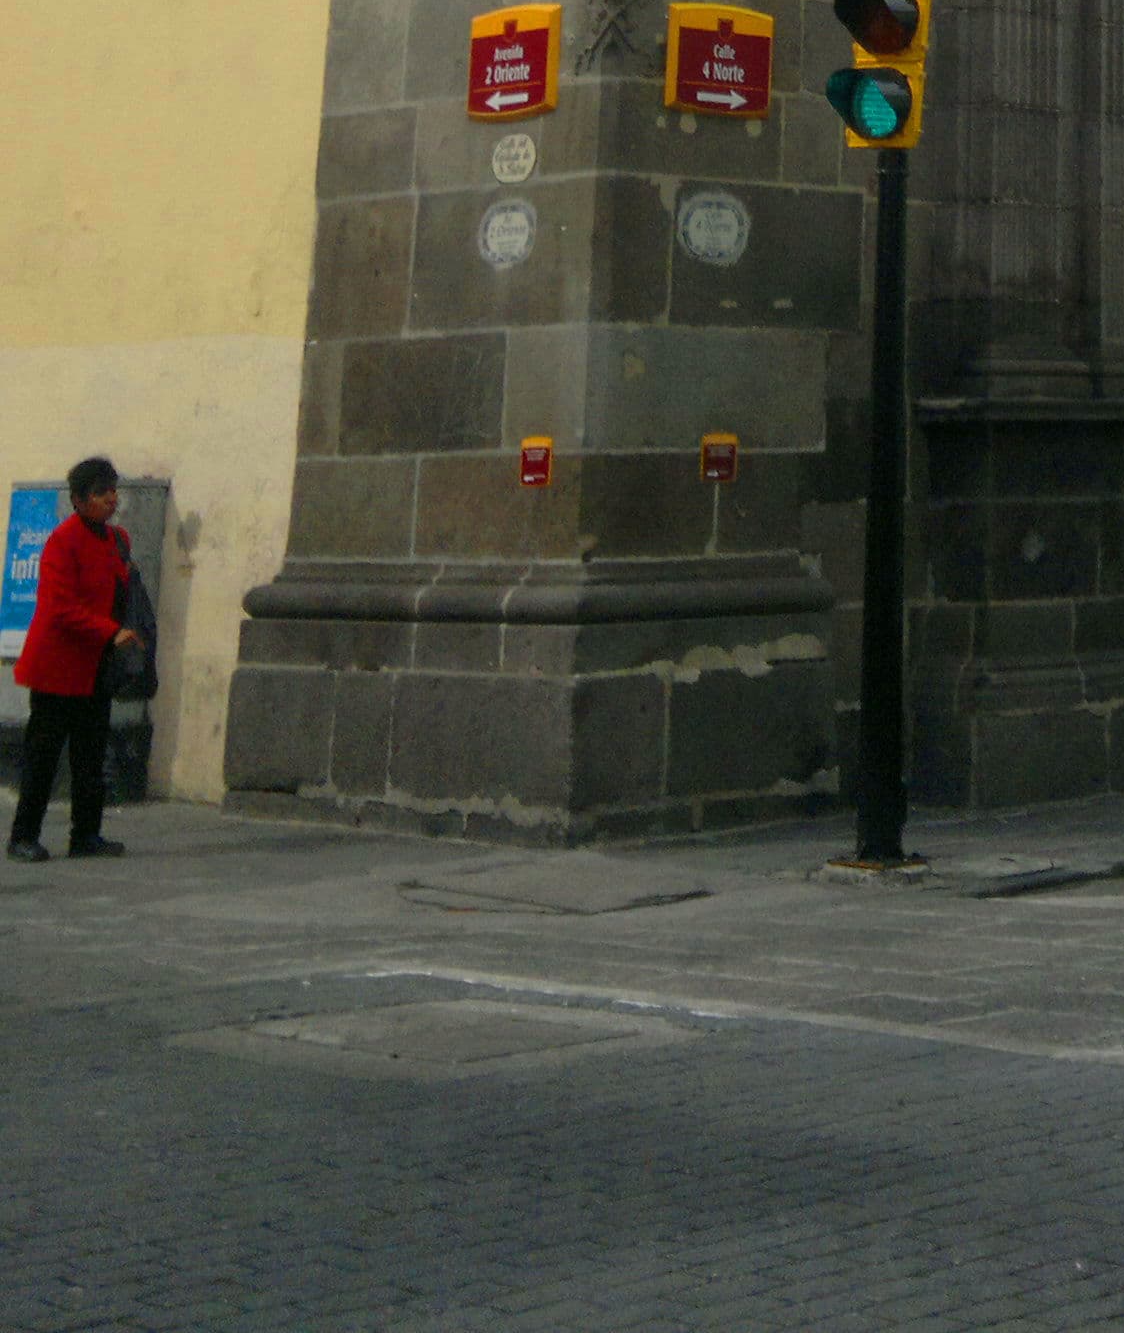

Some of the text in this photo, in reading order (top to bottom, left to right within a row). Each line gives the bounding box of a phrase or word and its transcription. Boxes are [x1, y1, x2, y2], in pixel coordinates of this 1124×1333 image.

[494, 44, 524, 61] Avenida
[713, 44, 736, 60] Calle
[485, 63, 531, 84] 2 Oriente
[702, 61, 745, 83] 4 Norte
